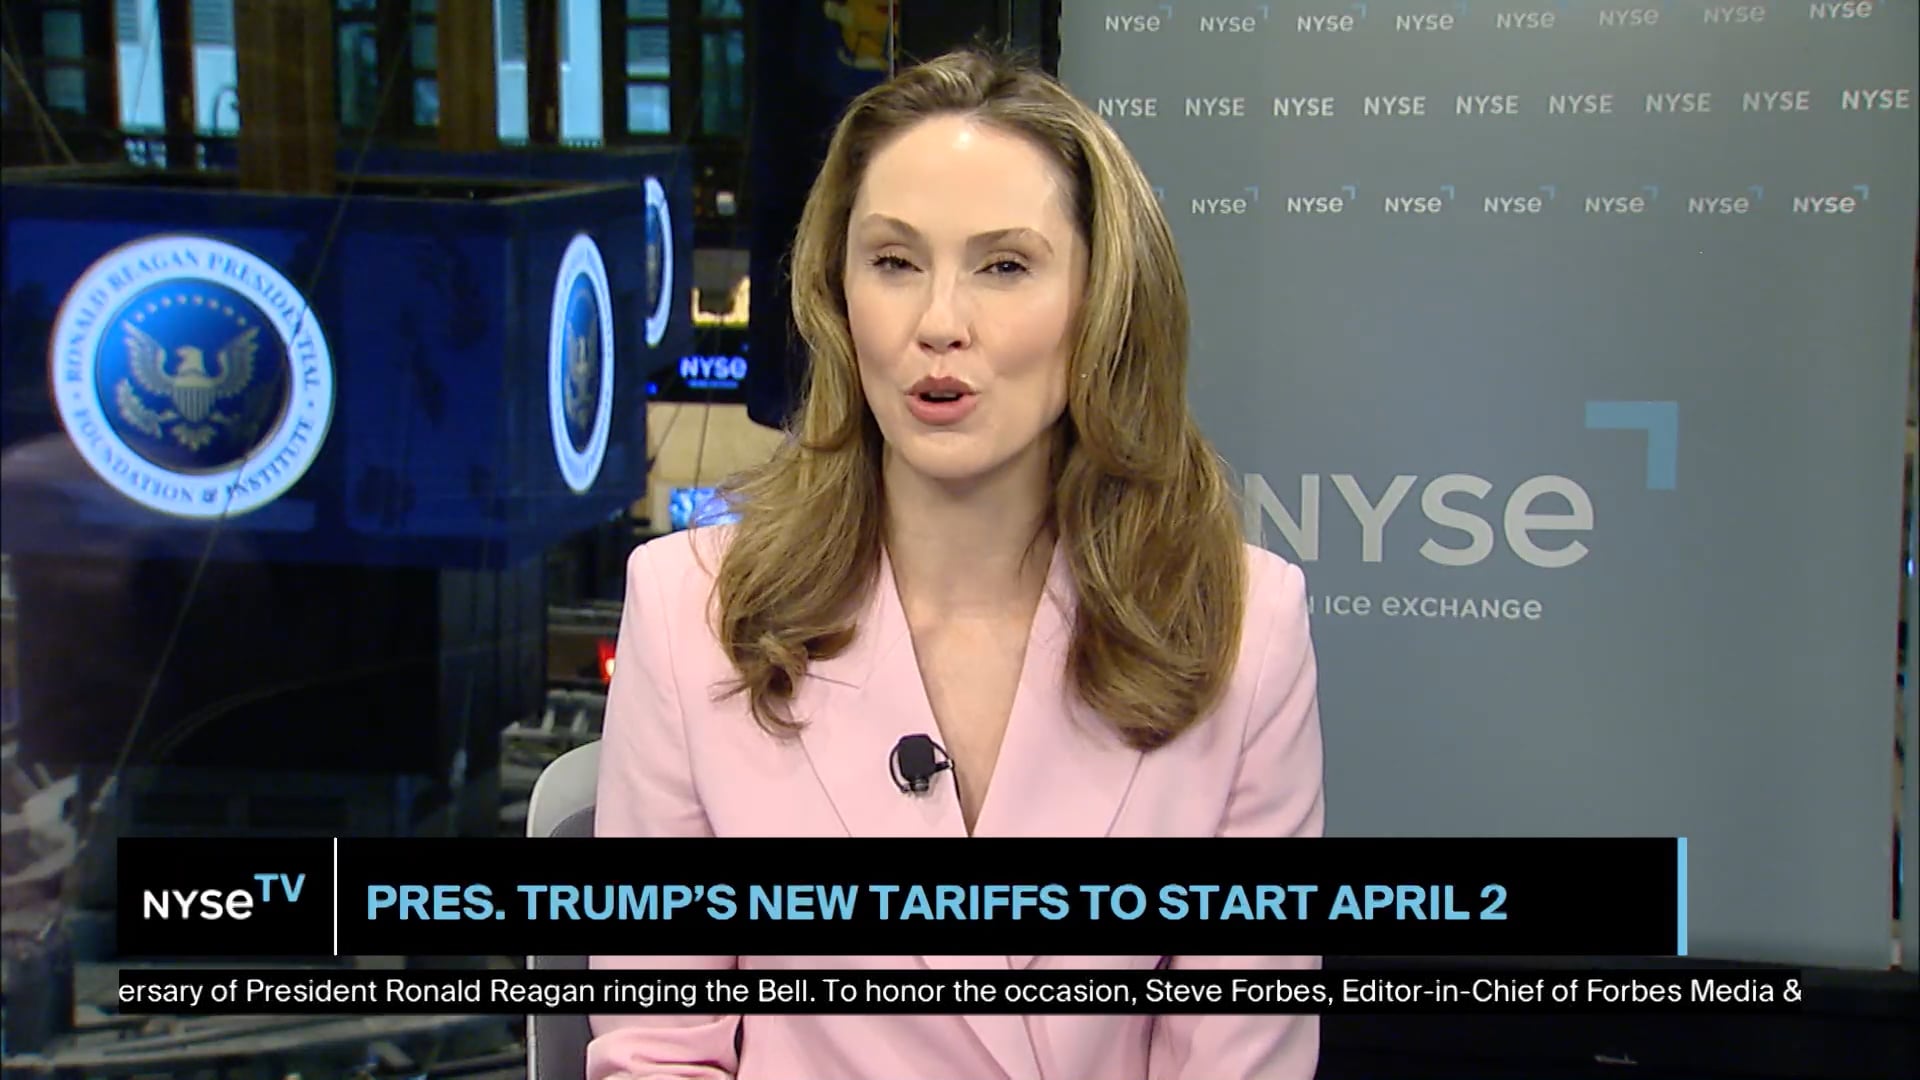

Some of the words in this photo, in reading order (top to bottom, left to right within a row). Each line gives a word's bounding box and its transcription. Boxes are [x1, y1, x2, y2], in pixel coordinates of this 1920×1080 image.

[1098, 98, 1157, 116] NYSE
[1185, 97, 1245, 116] NYSE
[1273, 97, 1334, 116] NYSE
[1364, 96, 1426, 116] NYSE
[1456, 95, 1518, 115] NYSE
[1549, 94, 1613, 114] NYSE
[1646, 93, 1711, 112] NYSE
[1743, 91, 1810, 111] NYSE
[1842, 89, 1910, 110] NYSE
[66, 287, 109, 383] RONALD
[107, 248, 200, 292] REAGAN
